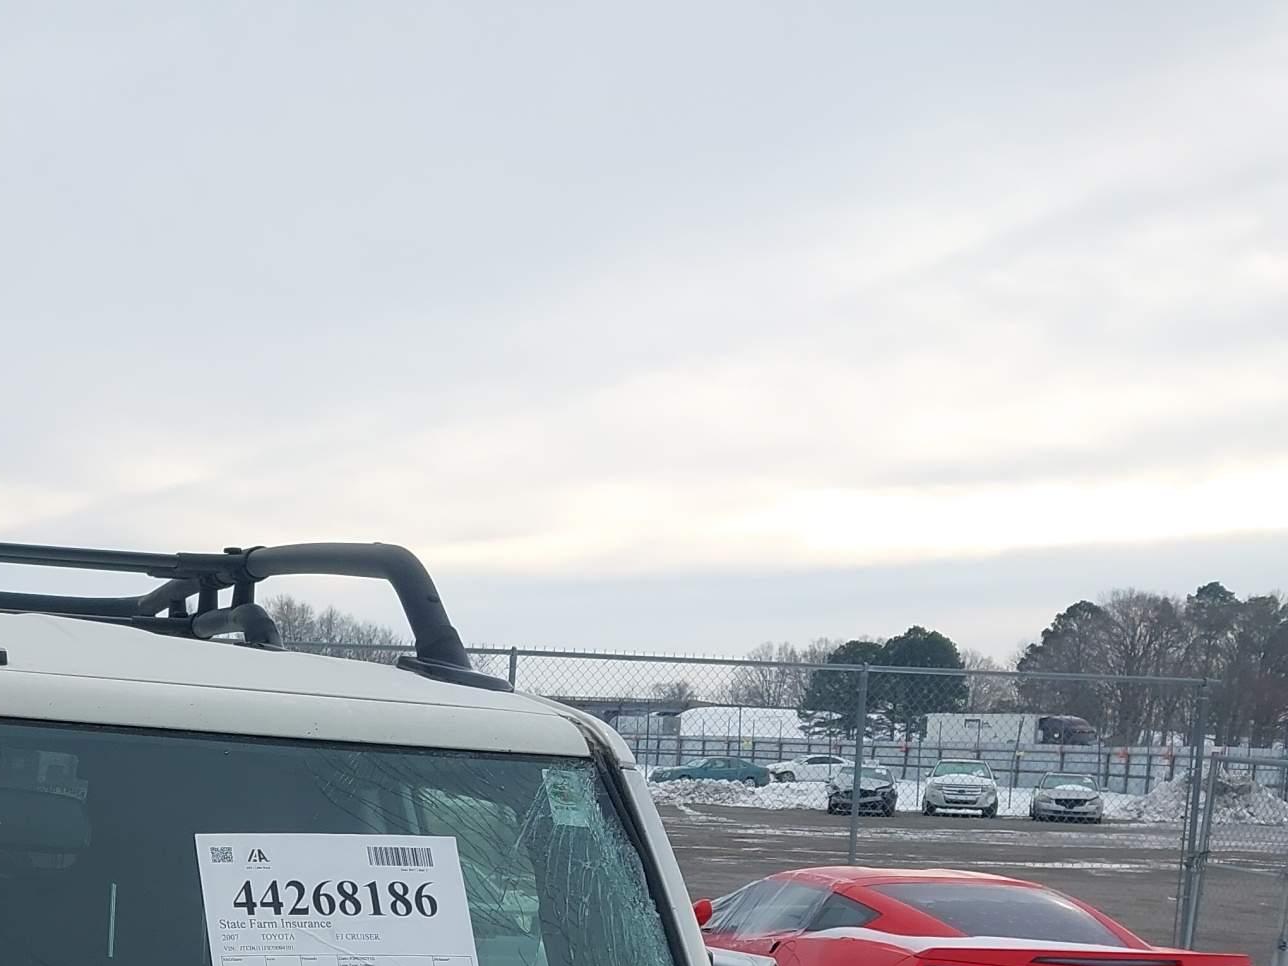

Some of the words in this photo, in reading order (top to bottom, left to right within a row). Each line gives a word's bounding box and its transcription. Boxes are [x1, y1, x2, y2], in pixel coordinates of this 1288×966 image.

[233, 879, 438, 918] 44268186
[219, 919, 246, 930] State
[249, 918, 278, 930] Farm
[281, 918, 332, 929] Insurance
[222, 933, 239, 942] 2007
[261, 933, 295, 941] TOYOTA
[345, 933, 381, 941] CRUISER
